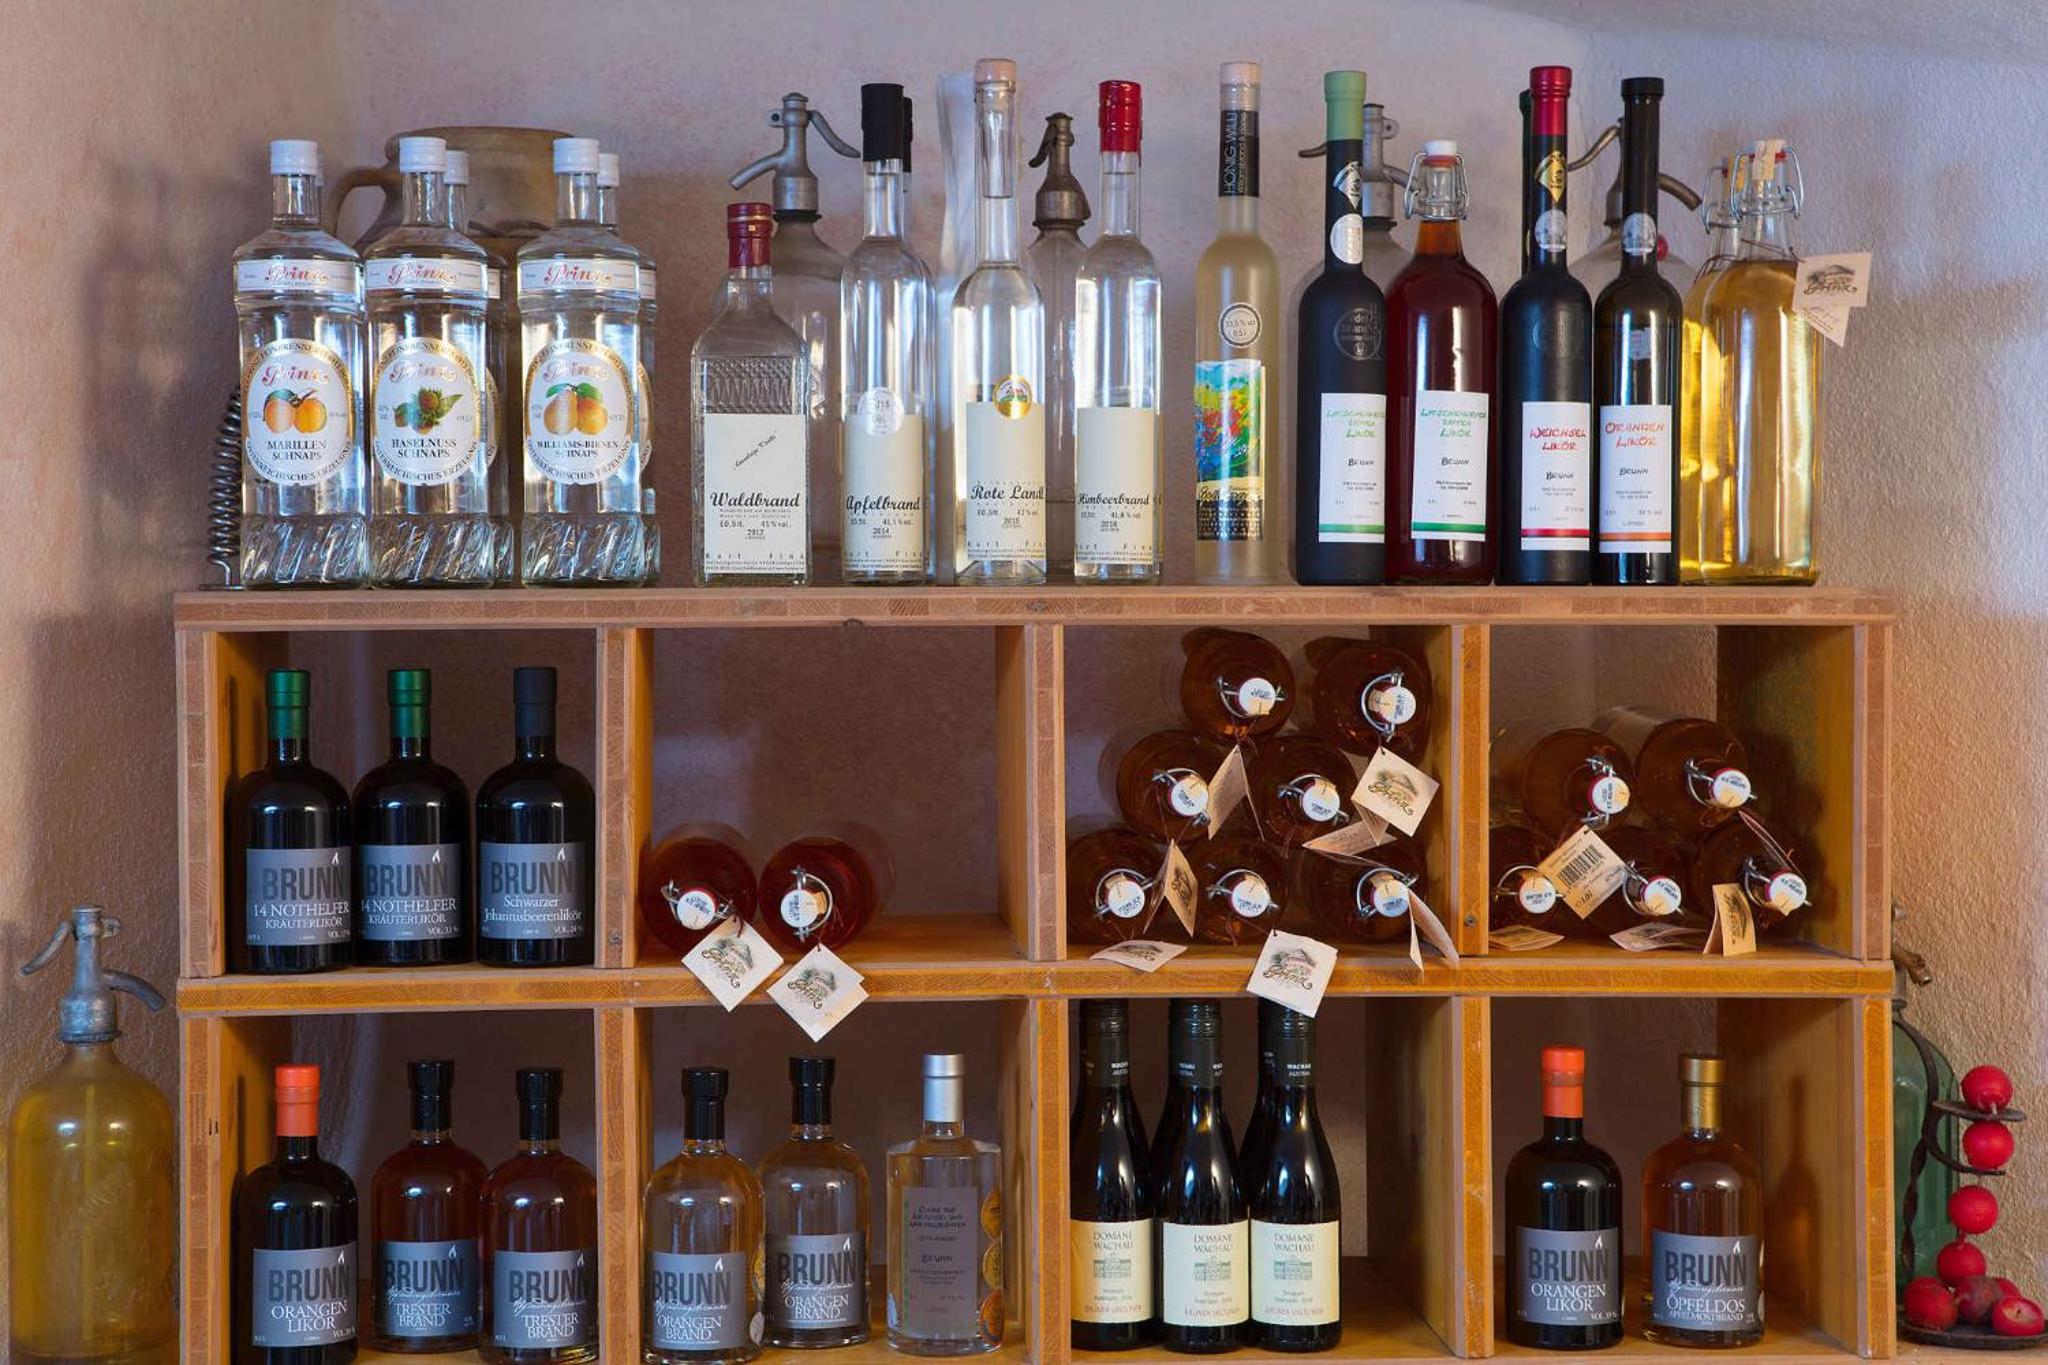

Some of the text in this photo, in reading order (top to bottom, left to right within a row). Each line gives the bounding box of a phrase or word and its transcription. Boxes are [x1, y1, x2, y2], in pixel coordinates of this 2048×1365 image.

[267, 439, 327, 450] MARILLEN
[392, 438, 456, 448] HASELNUSS
[272, 451, 322, 461] SCHNAPS
[398, 449, 449, 459] SCHNAPS
[555, 449, 599, 458] SCHNAPS
[710, 492, 801, 507] Waldbrand
[970, 485, 1005, 500] Rote
[846, 495, 921, 514] Apfelbrand
[262, 866, 346, 901] BRUNN
[366, 863, 449, 897] BRUNN
[491, 862, 574, 894] BRUNN
[271, 901, 349, 917] NOTHELFER
[373, 898, 456, 912] NOTHELFER
[503, 895, 559, 908] Schwarzer
[777, 1253, 857, 1284] BRUNN
[1528, 1248, 1609, 1282] BRUNN
[1665, 1251, 1746, 1286] BRUNN
[384, 1259, 464, 1292] BRUNN
[268, 1265, 350, 1302] BRUNN
[652, 1270, 731, 1305] BRUNN
[1531, 1282, 1606, 1298] ORANGEN
[785, 1294, 848, 1307] ORANGEN
[271, 1300, 347, 1320] ORANGEN
[394, 1303, 452, 1315] TRESTER
[795, 1306, 841, 1319] BRAND
[399, 1314, 445, 1327] BRAND
[523, 1312, 580, 1328] TRESTER
[658, 1315, 722, 1329] ORANGEN
[528, 1325, 575, 1339] BRAND
[665, 1327, 712, 1341] BRAND
